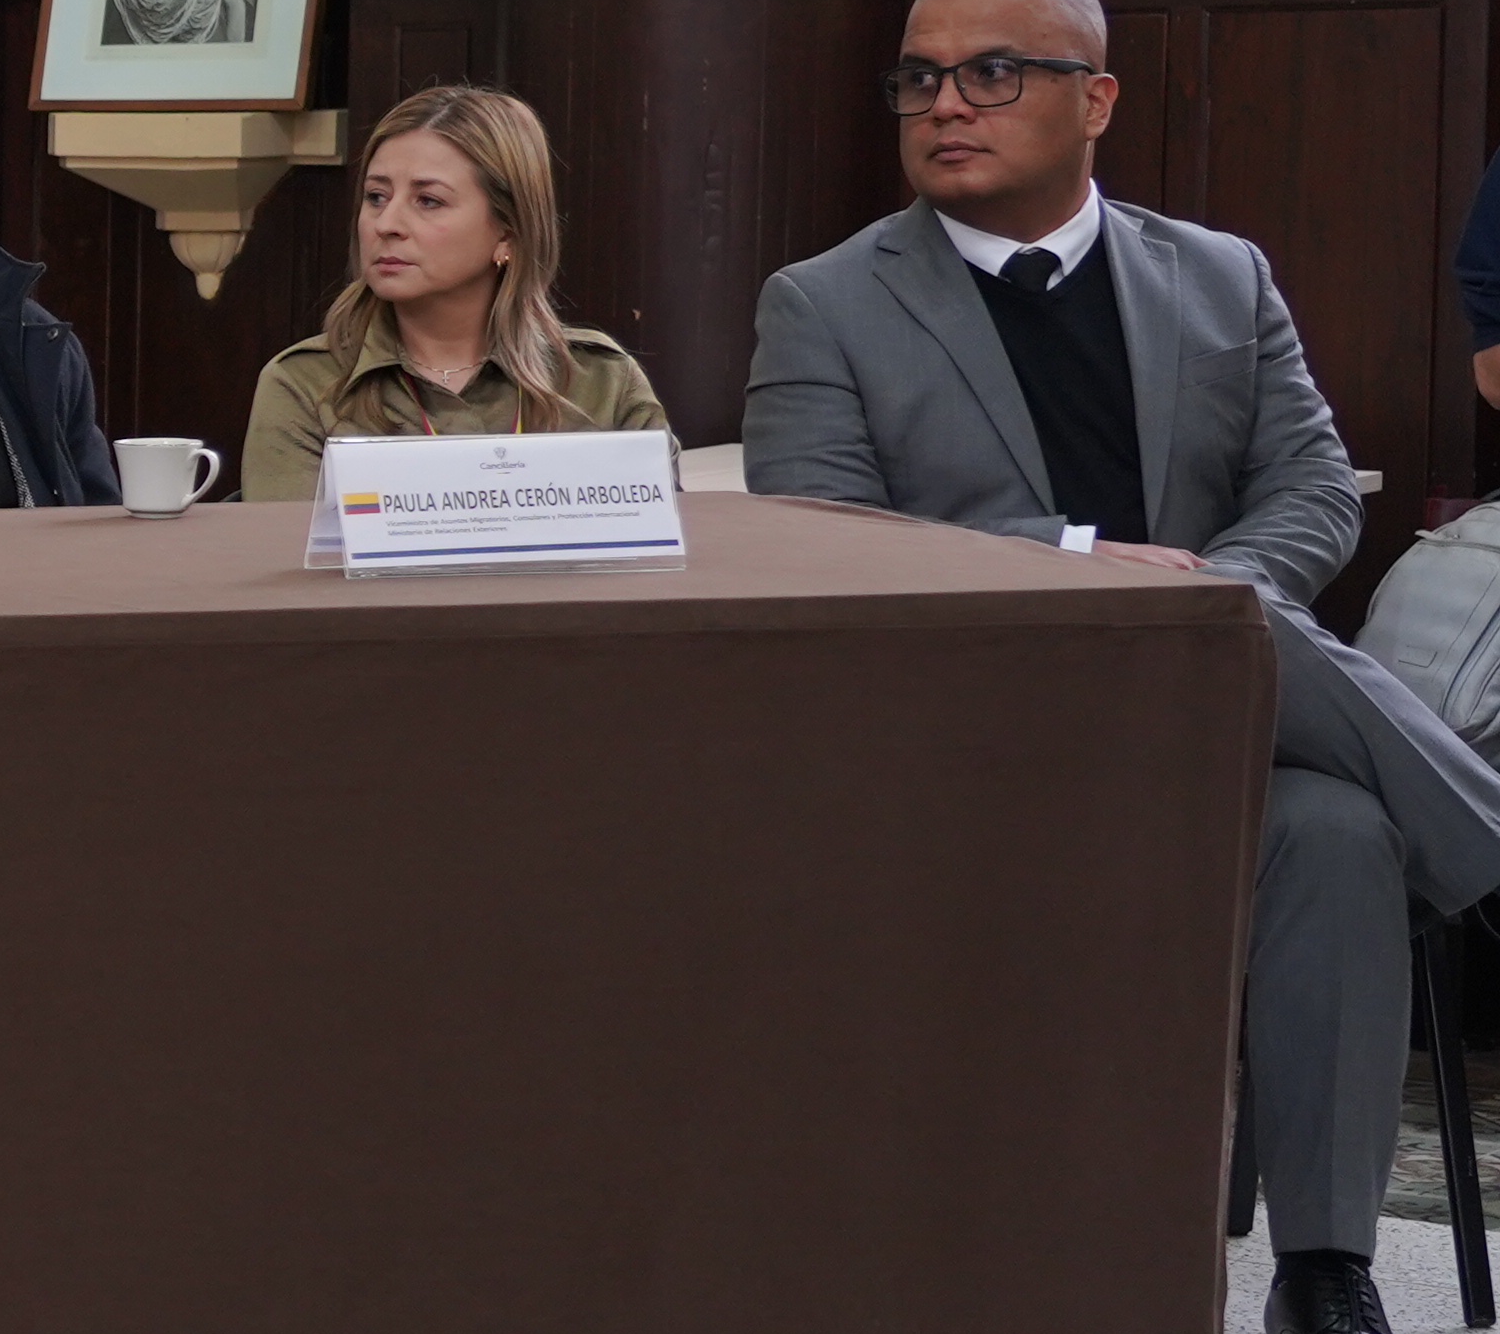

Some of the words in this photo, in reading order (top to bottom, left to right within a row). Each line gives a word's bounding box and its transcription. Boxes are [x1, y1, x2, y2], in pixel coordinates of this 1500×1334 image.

[383, 493, 437, 513] PAULA
[442, 489, 511, 510] ANDREA
[515, 482, 571, 507] CERÓN
[577, 484, 664, 505] ARBOLEDA
